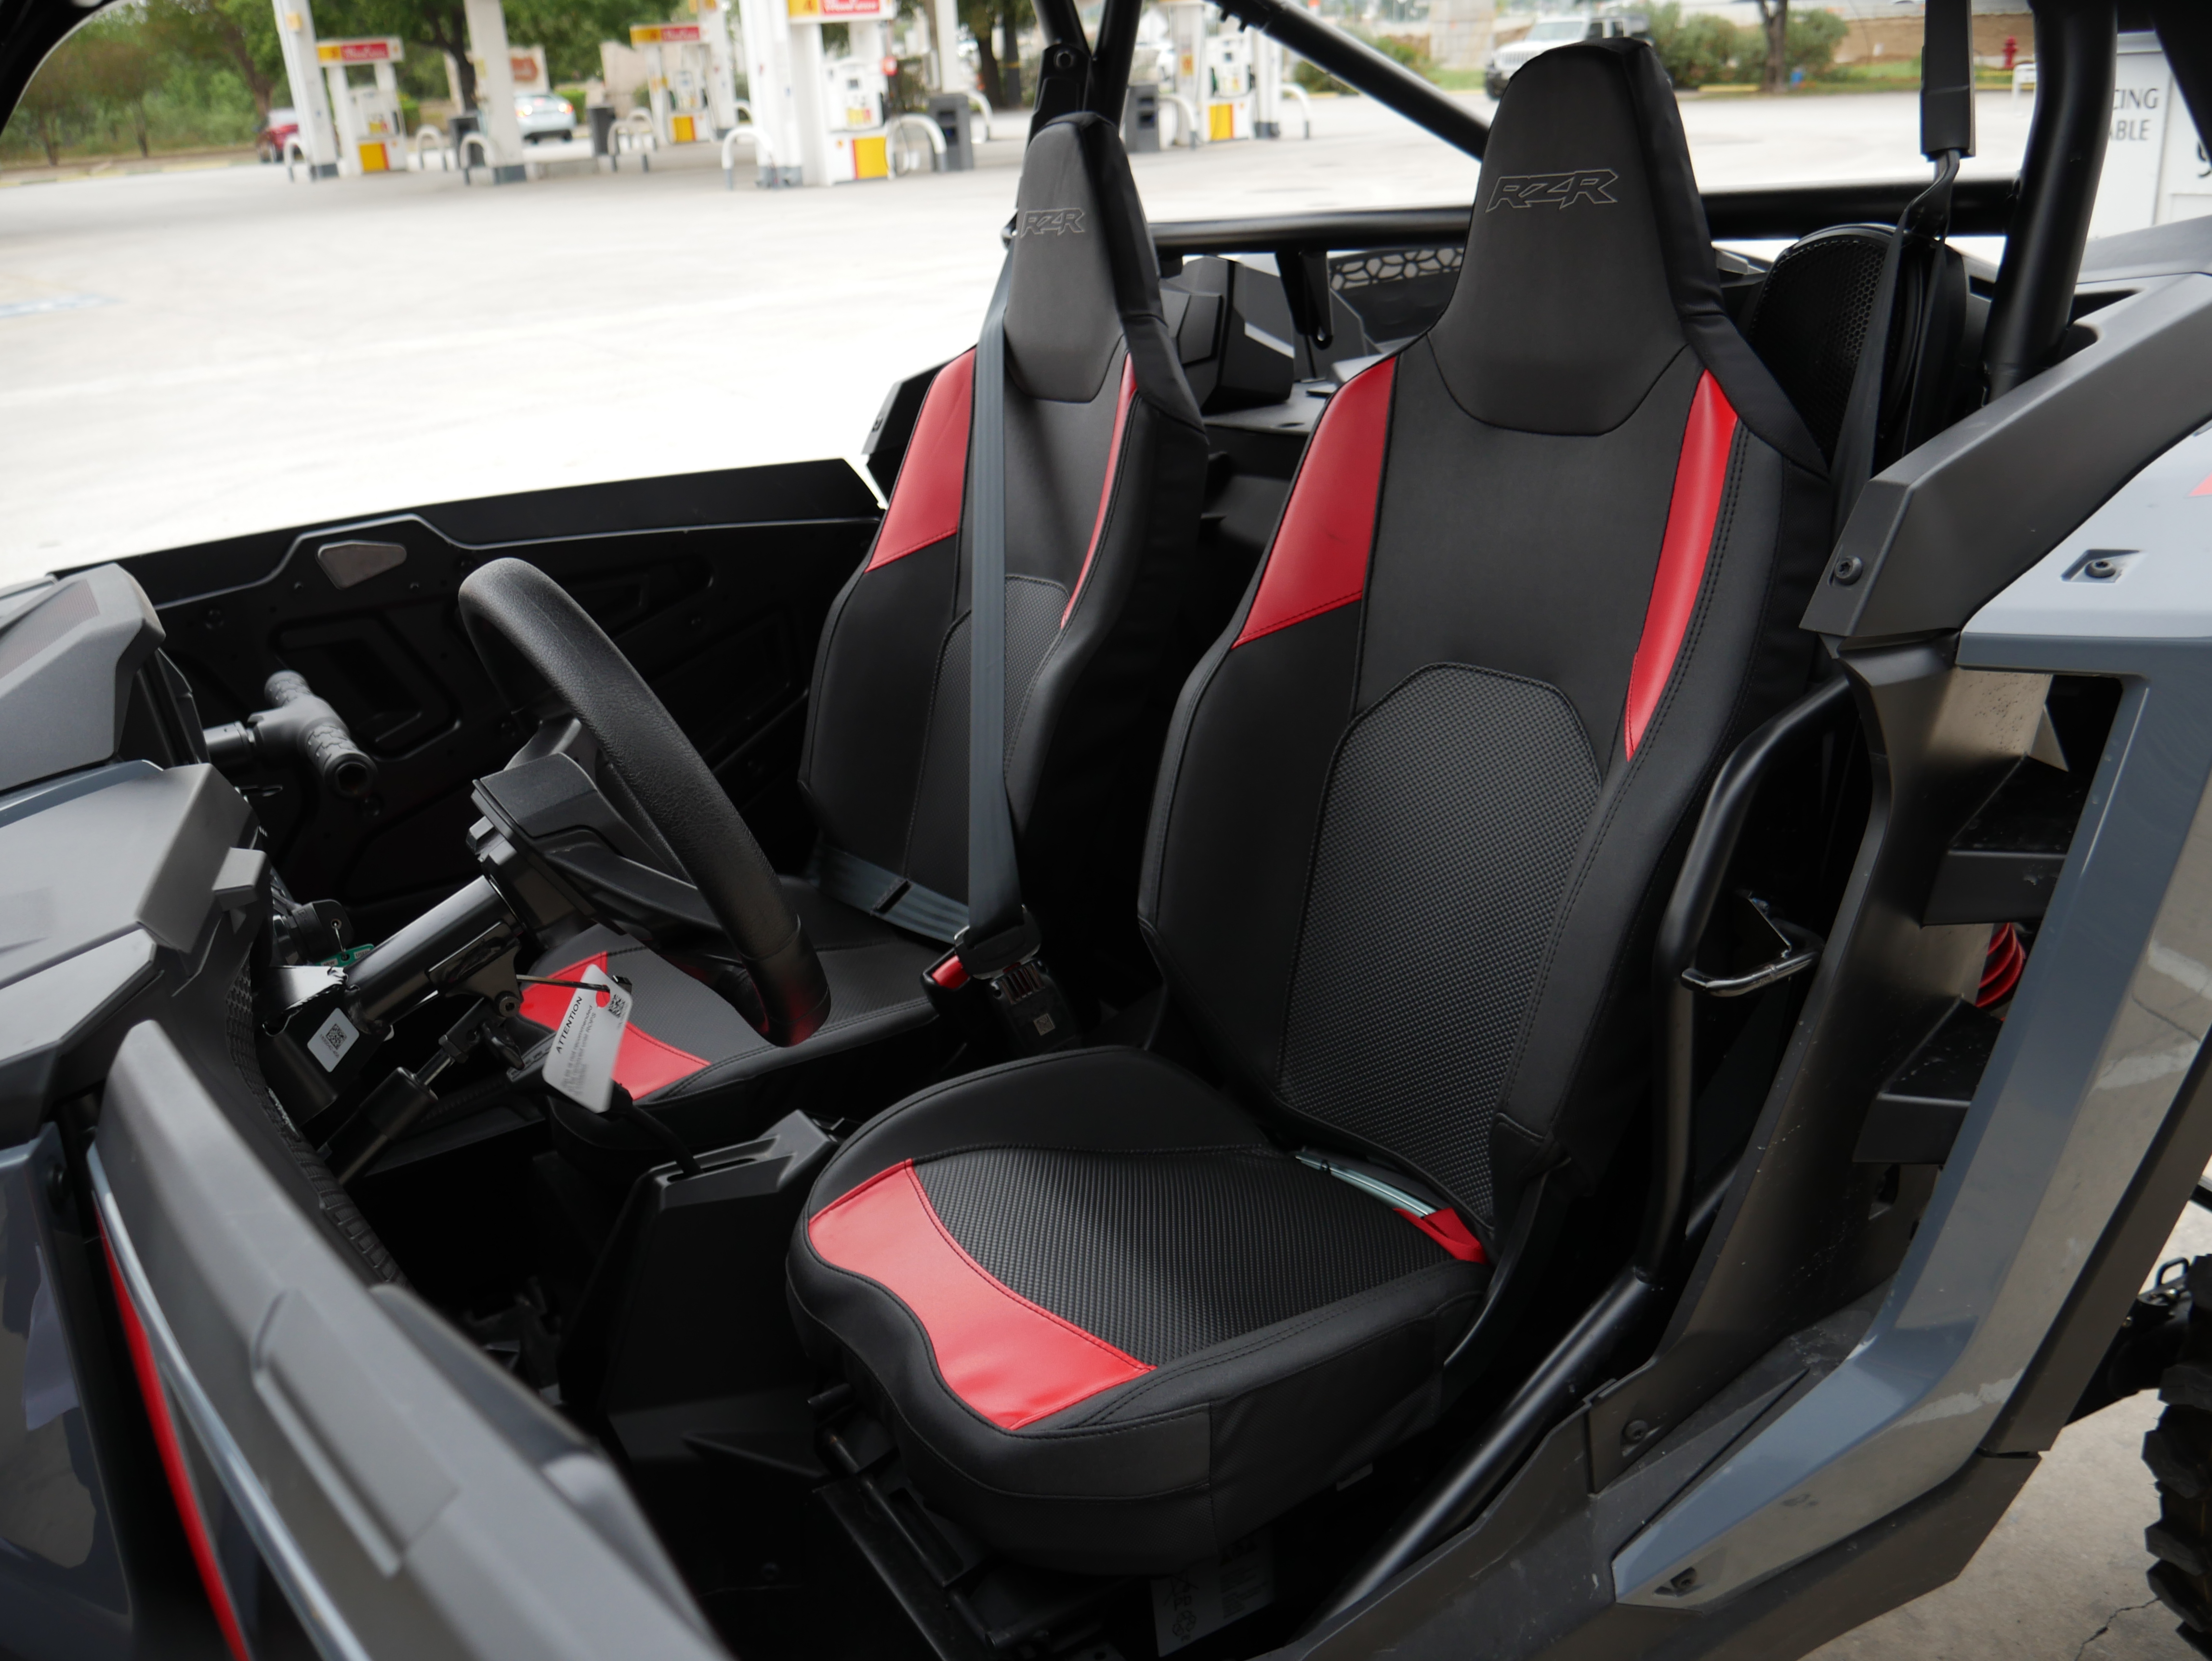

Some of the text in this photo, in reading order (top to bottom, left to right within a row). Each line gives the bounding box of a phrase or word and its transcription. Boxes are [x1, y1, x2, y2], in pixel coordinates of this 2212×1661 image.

[2109, 119, 2151, 140] BLE
[1485, 169, 1619, 213] RZR
[1020, 208, 1085, 238] RZR
[556, 996, 582, 1054] ATTENTION
